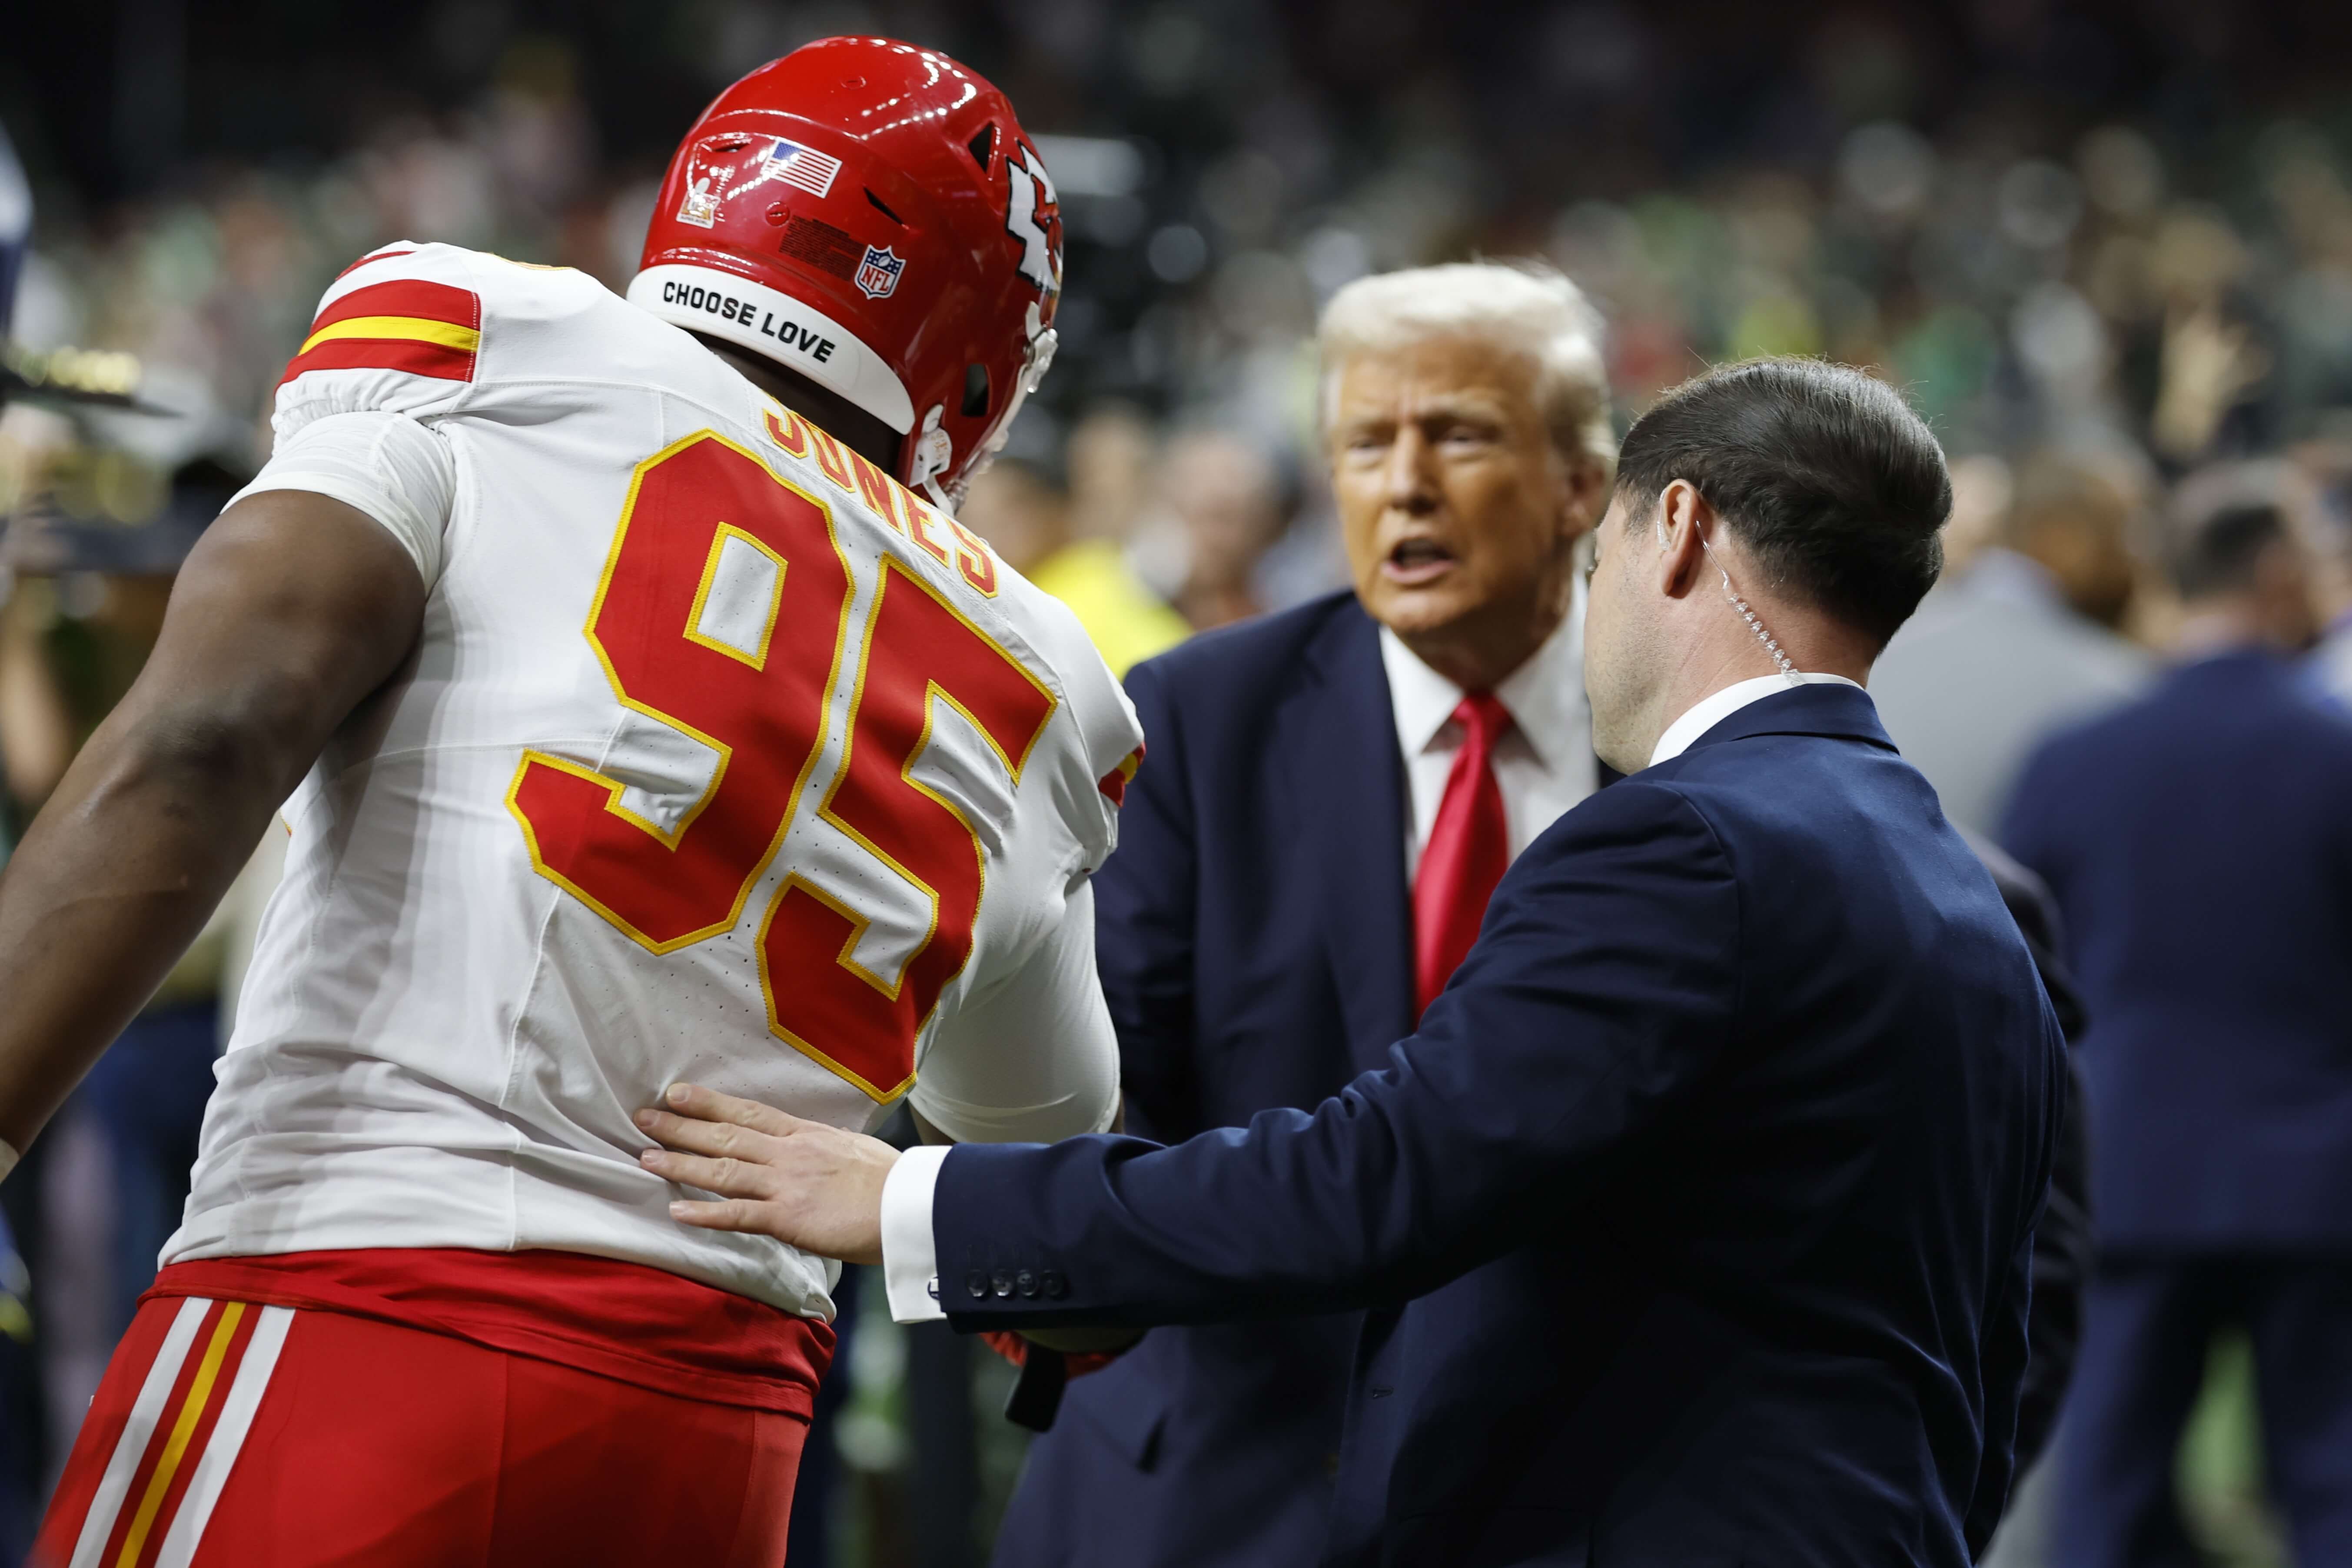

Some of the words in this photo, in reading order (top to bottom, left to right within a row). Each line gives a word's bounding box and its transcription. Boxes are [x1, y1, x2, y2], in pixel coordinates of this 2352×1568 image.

[663, 281, 757, 327] CHOOSE
[761, 312, 836, 364] LOVE
[860, 264, 890, 292] NFL
[762, 396, 998, 599] JONES
[504, 428, 1059, 1106] 95
